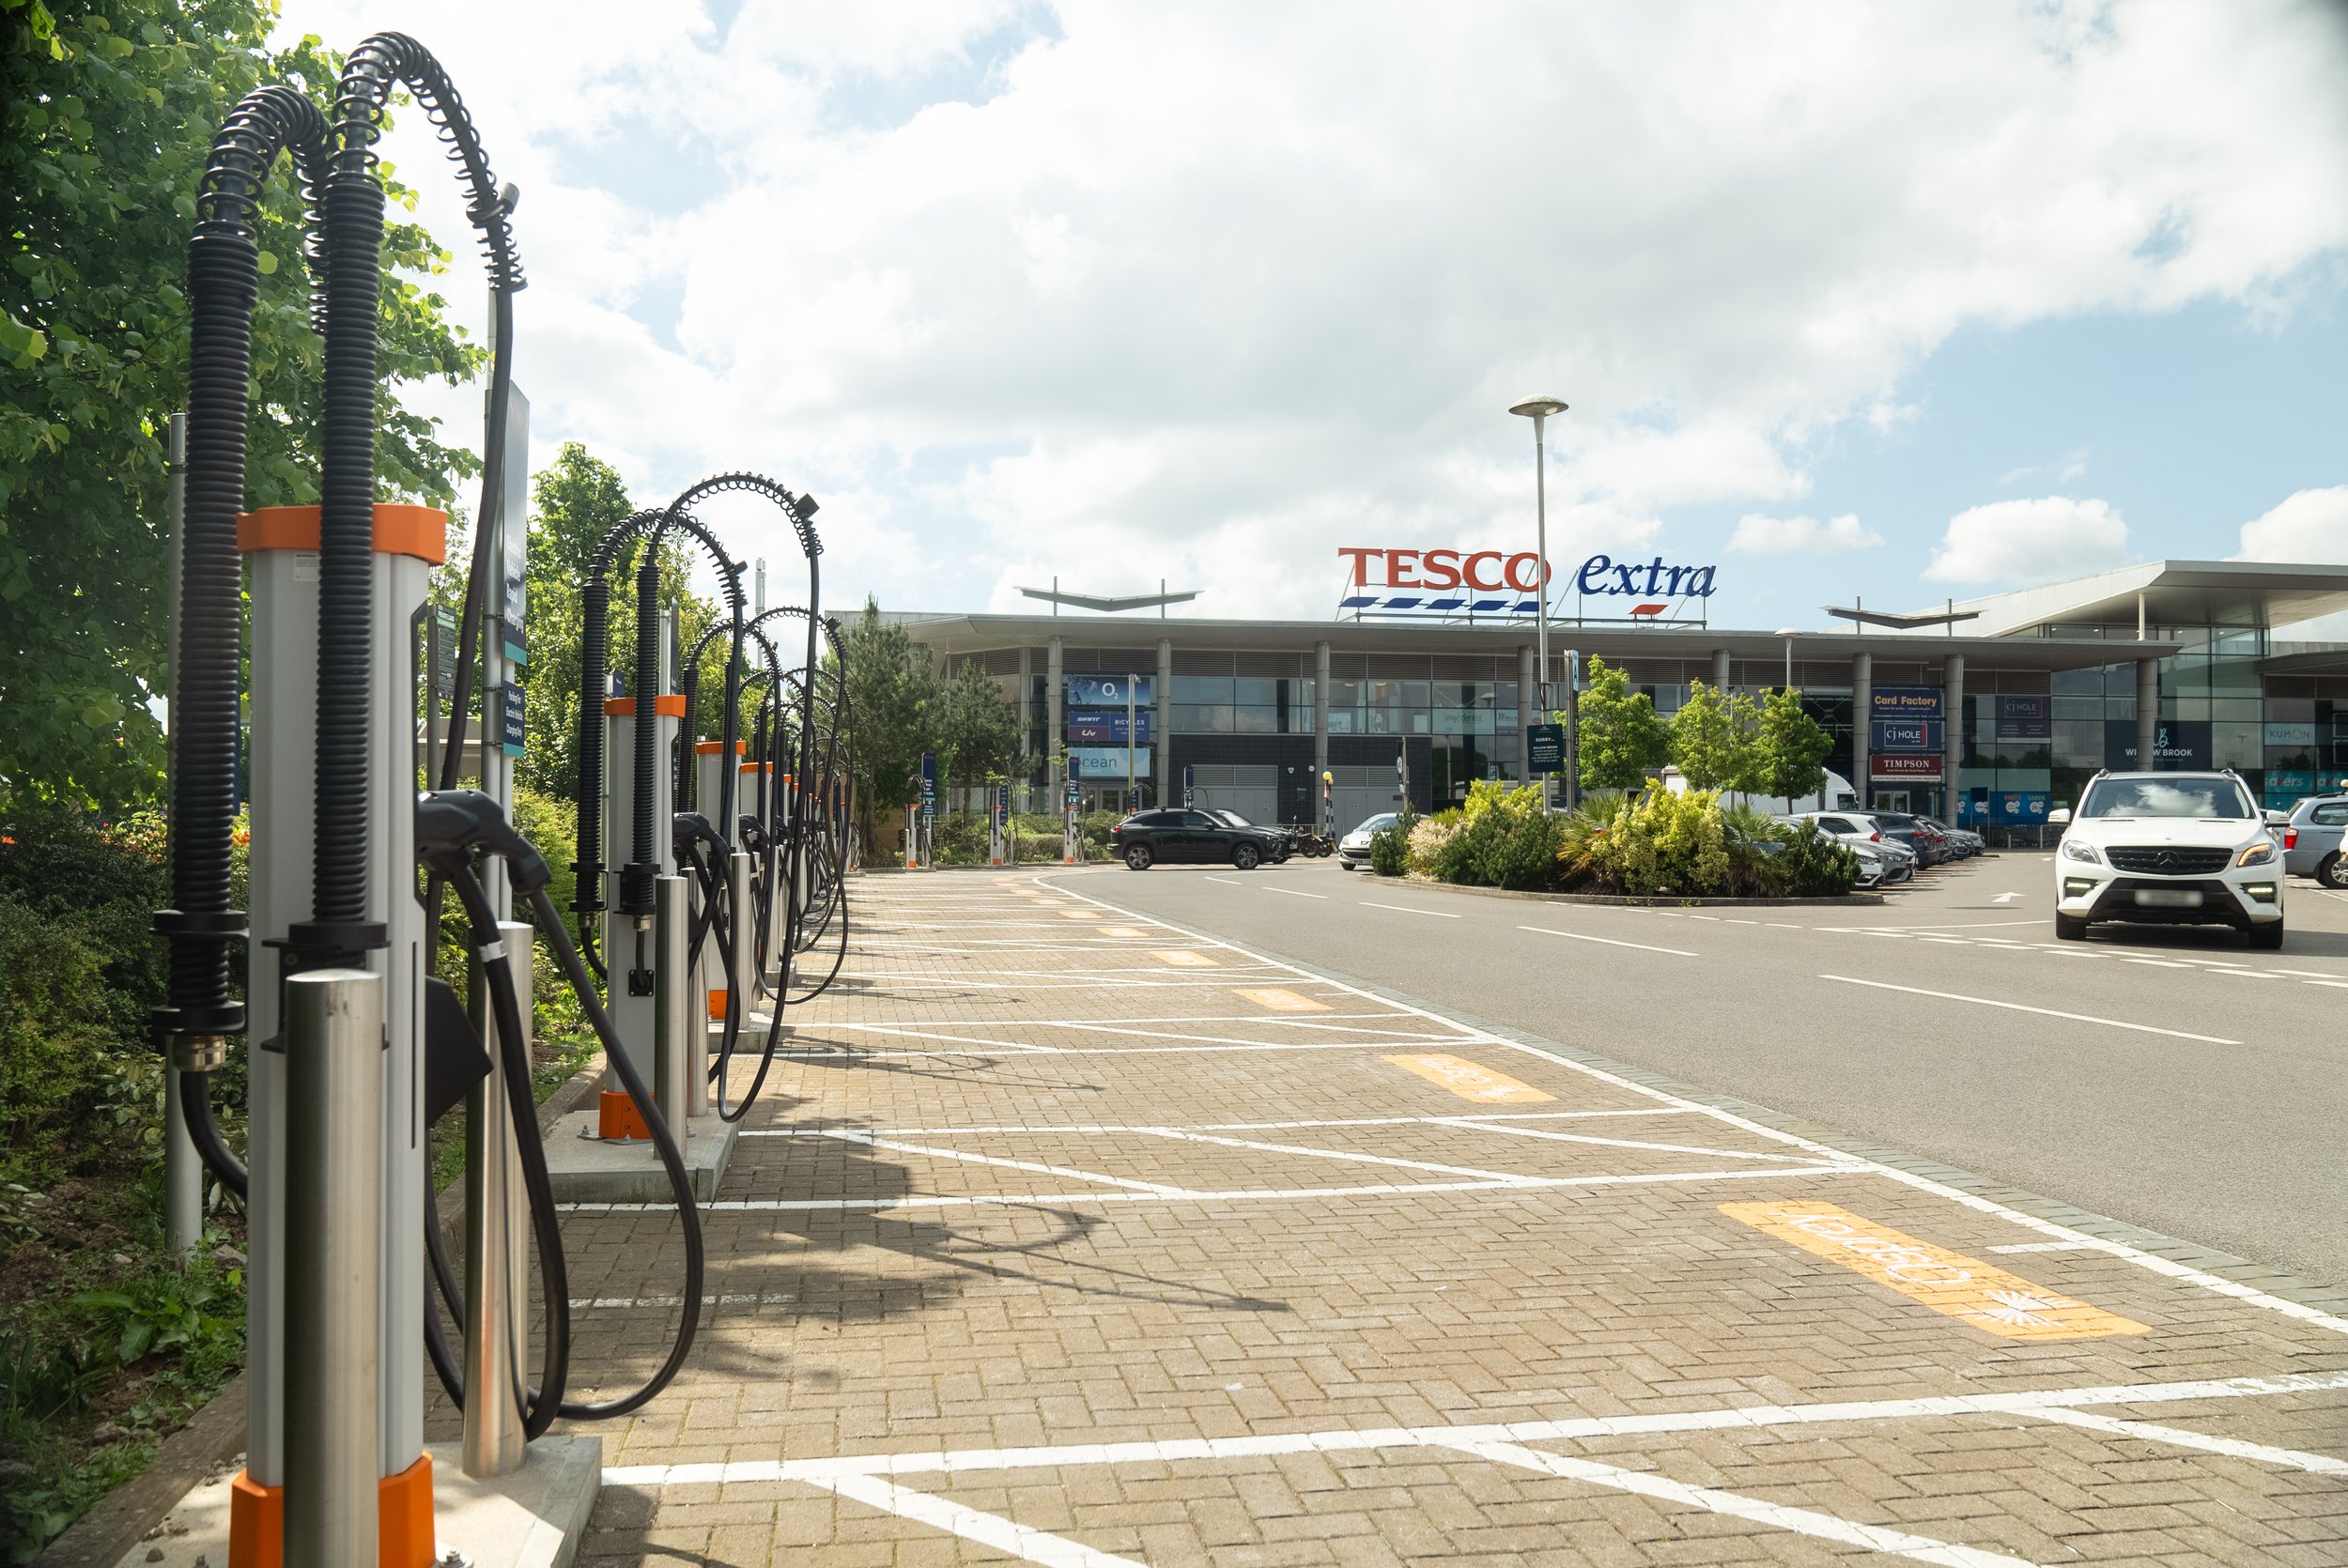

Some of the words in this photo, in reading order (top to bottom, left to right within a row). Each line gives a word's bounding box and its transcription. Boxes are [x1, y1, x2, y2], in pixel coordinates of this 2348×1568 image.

[1337, 547, 1552, 593] TESCO
[1577, 555, 1718, 598] extra
[1875, 696, 1897, 705] Card
[1901, 697, 1937, 707] Factory
[1898, 730, 1921, 739] HOLE
[2269, 729, 2309, 740] KUMON
[2162, 748, 2193, 757] BROOK
[1079, 758, 1118, 767] cean
[1884, 760, 1929, 768] TIMPSON
